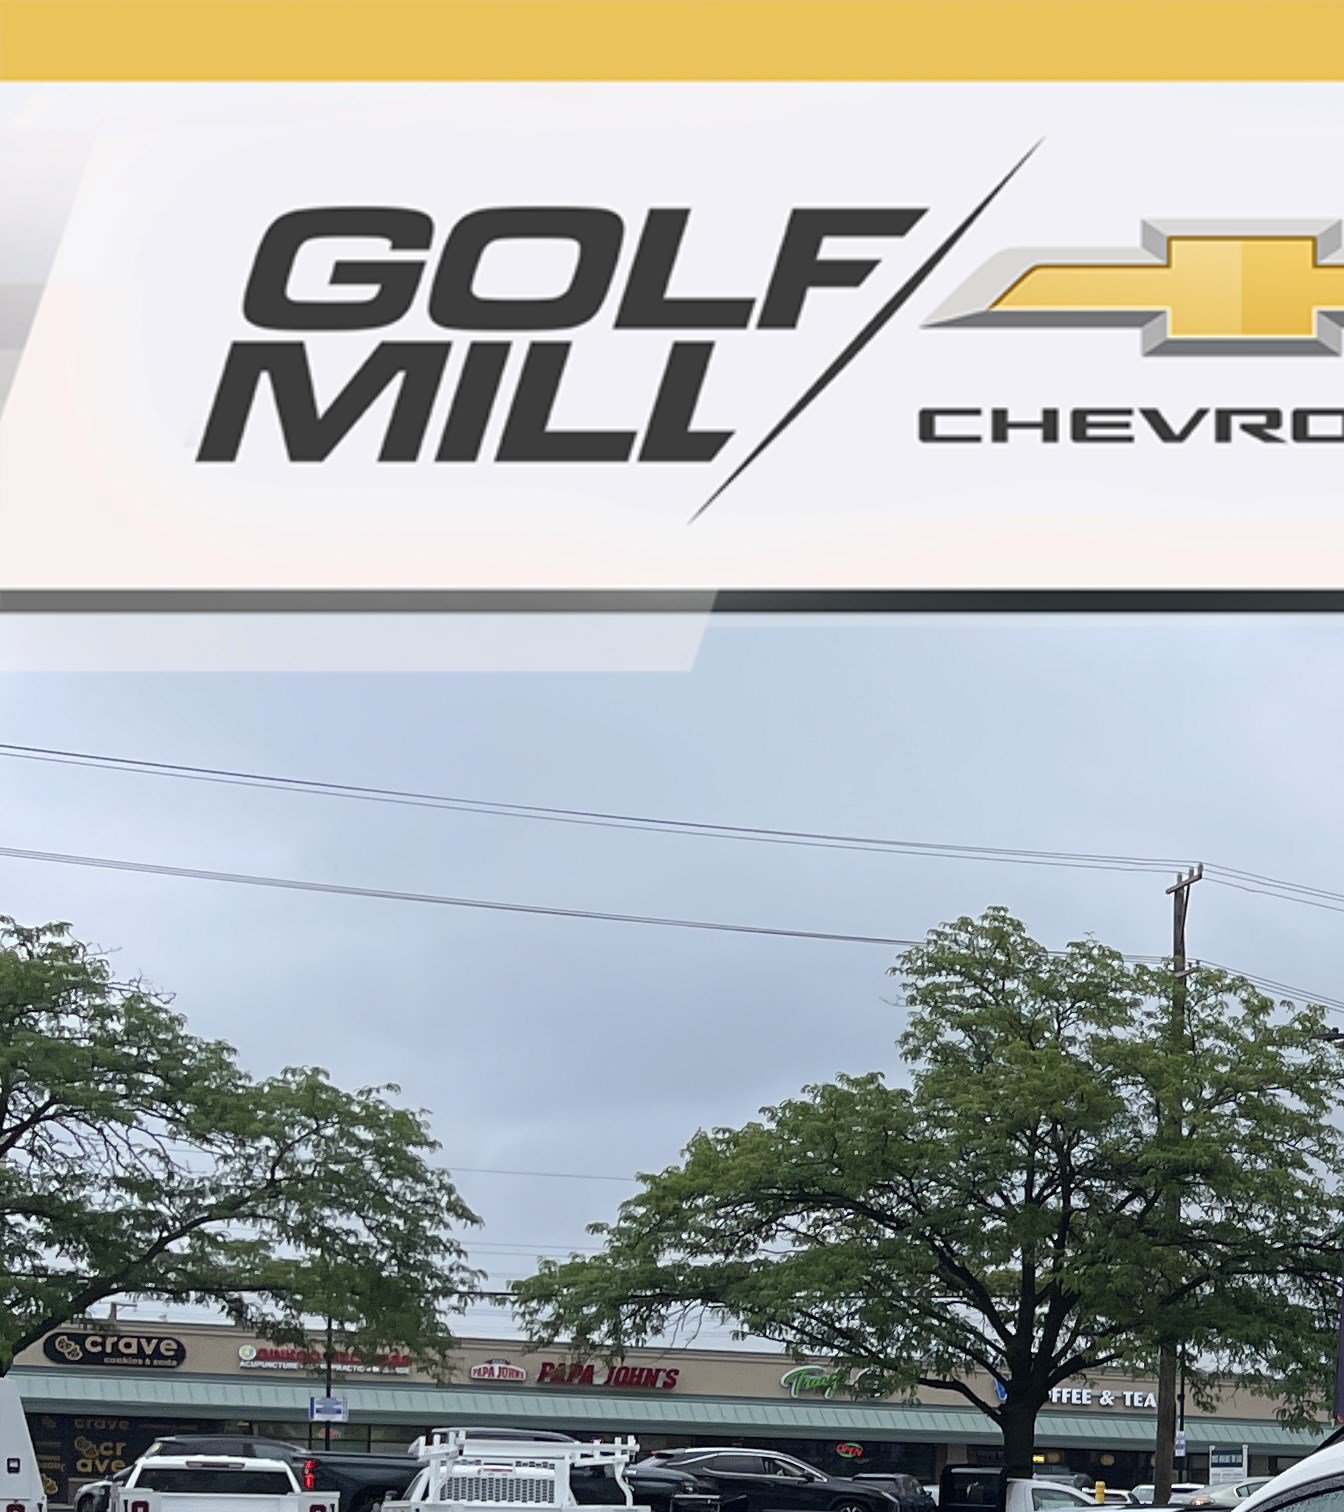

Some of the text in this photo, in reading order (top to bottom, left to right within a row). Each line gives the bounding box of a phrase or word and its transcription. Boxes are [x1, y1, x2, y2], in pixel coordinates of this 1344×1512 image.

[84, 1335, 179, 1357] crave
[473, 1366, 494, 1378] PAPA
[537, 1362, 594, 1386] PAPA
[1048, 1387, 1157, 1408] FFEE & TEA
